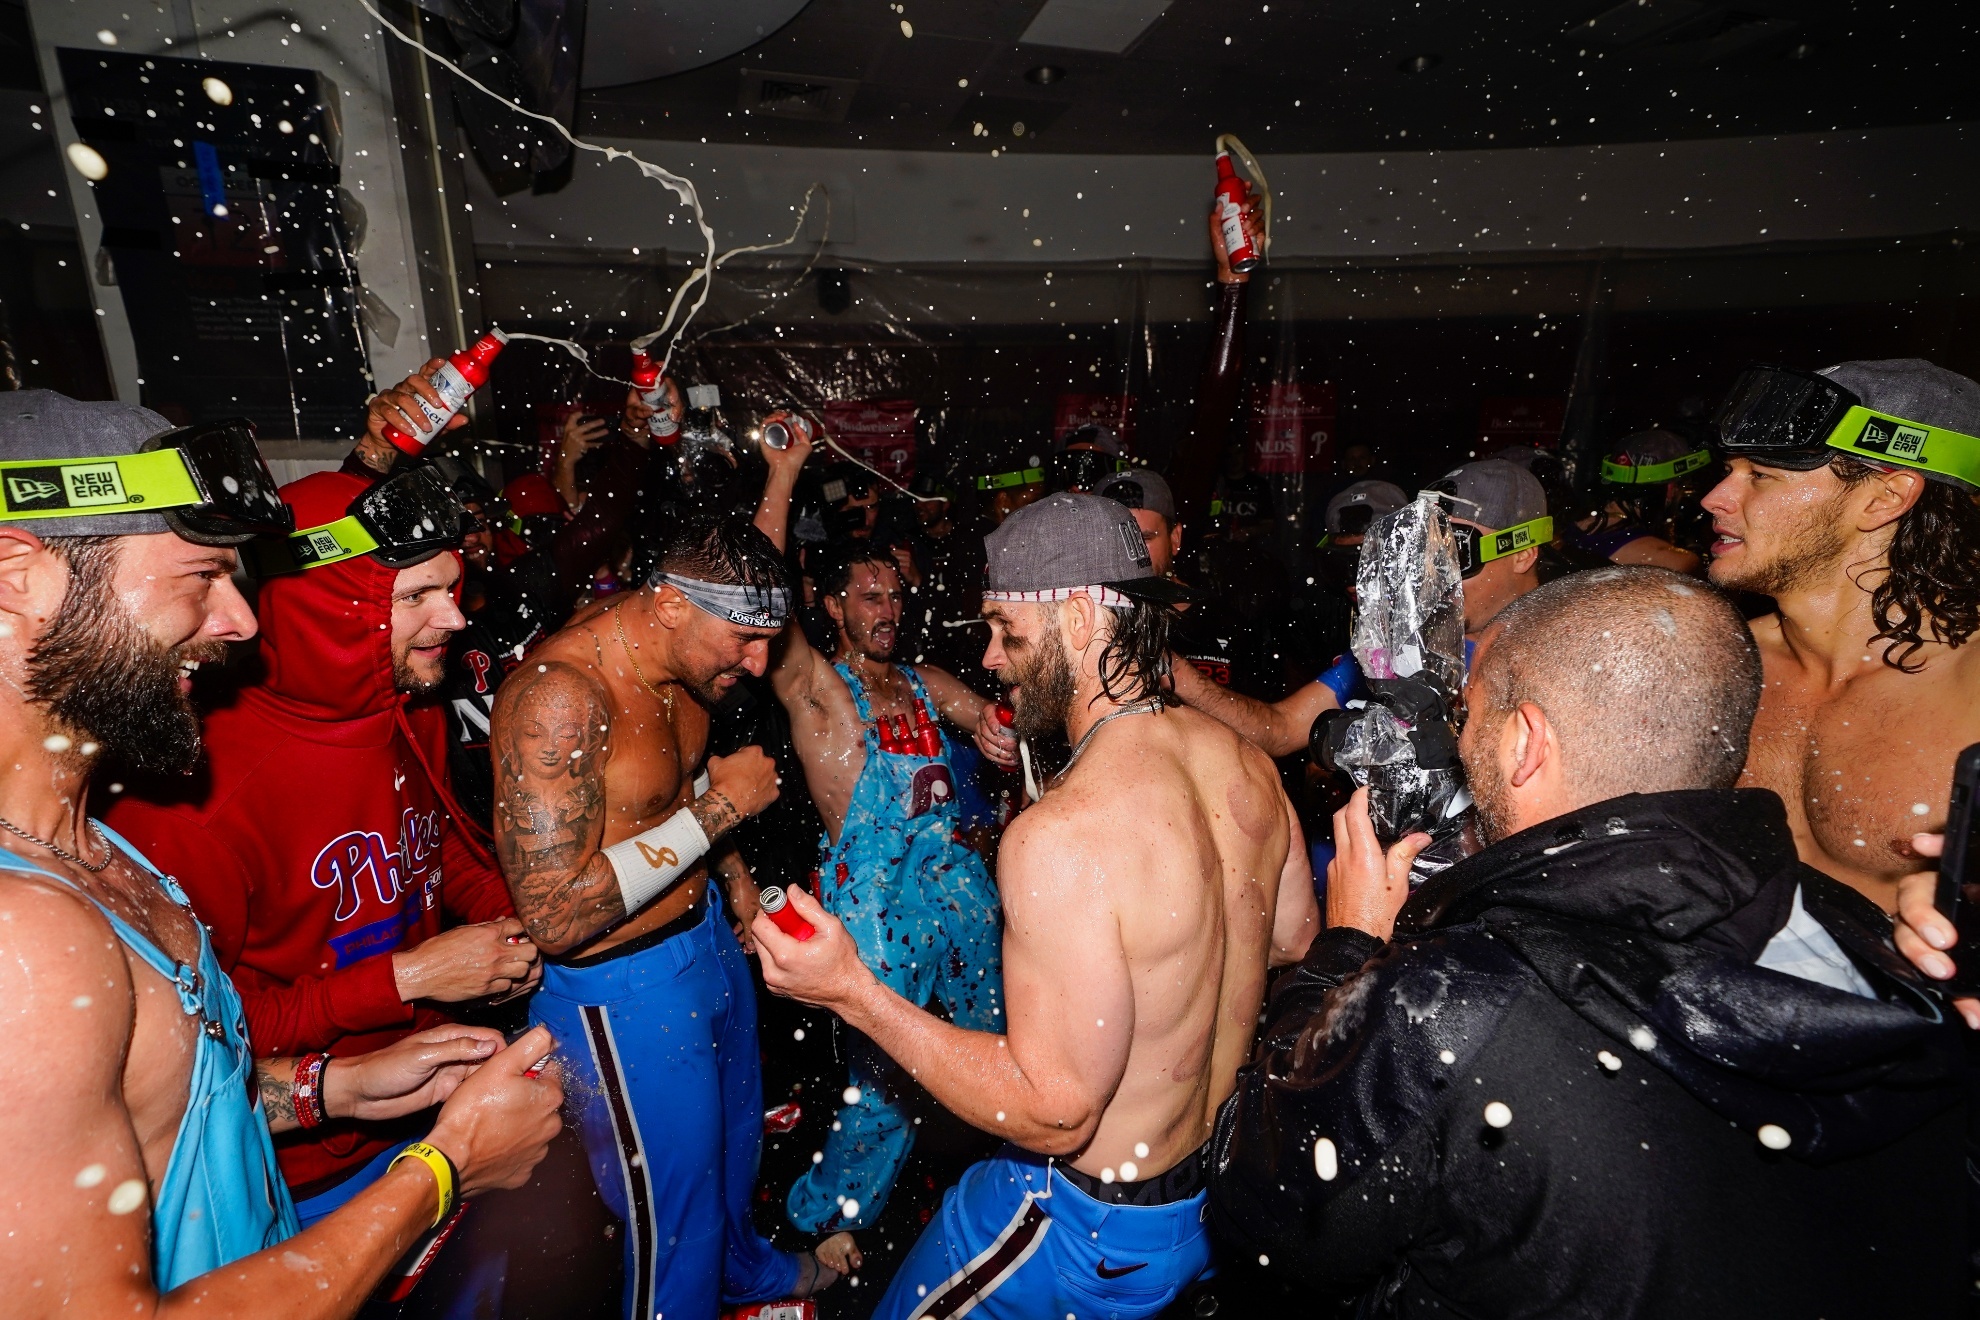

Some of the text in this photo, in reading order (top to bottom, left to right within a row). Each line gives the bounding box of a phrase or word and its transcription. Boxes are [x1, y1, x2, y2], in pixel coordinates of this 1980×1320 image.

[838, 418, 900, 433] Budweiser
[1896, 431, 1922, 445] NEW
[1254, 439, 1297, 454] NLDS
[1892, 442, 1918, 455] ERA
[70, 471, 113, 486] NEW
[74, 483, 117, 498] ERA
[1514, 530, 1528, 539] NEW
[1516, 536, 1529, 545] ERA
